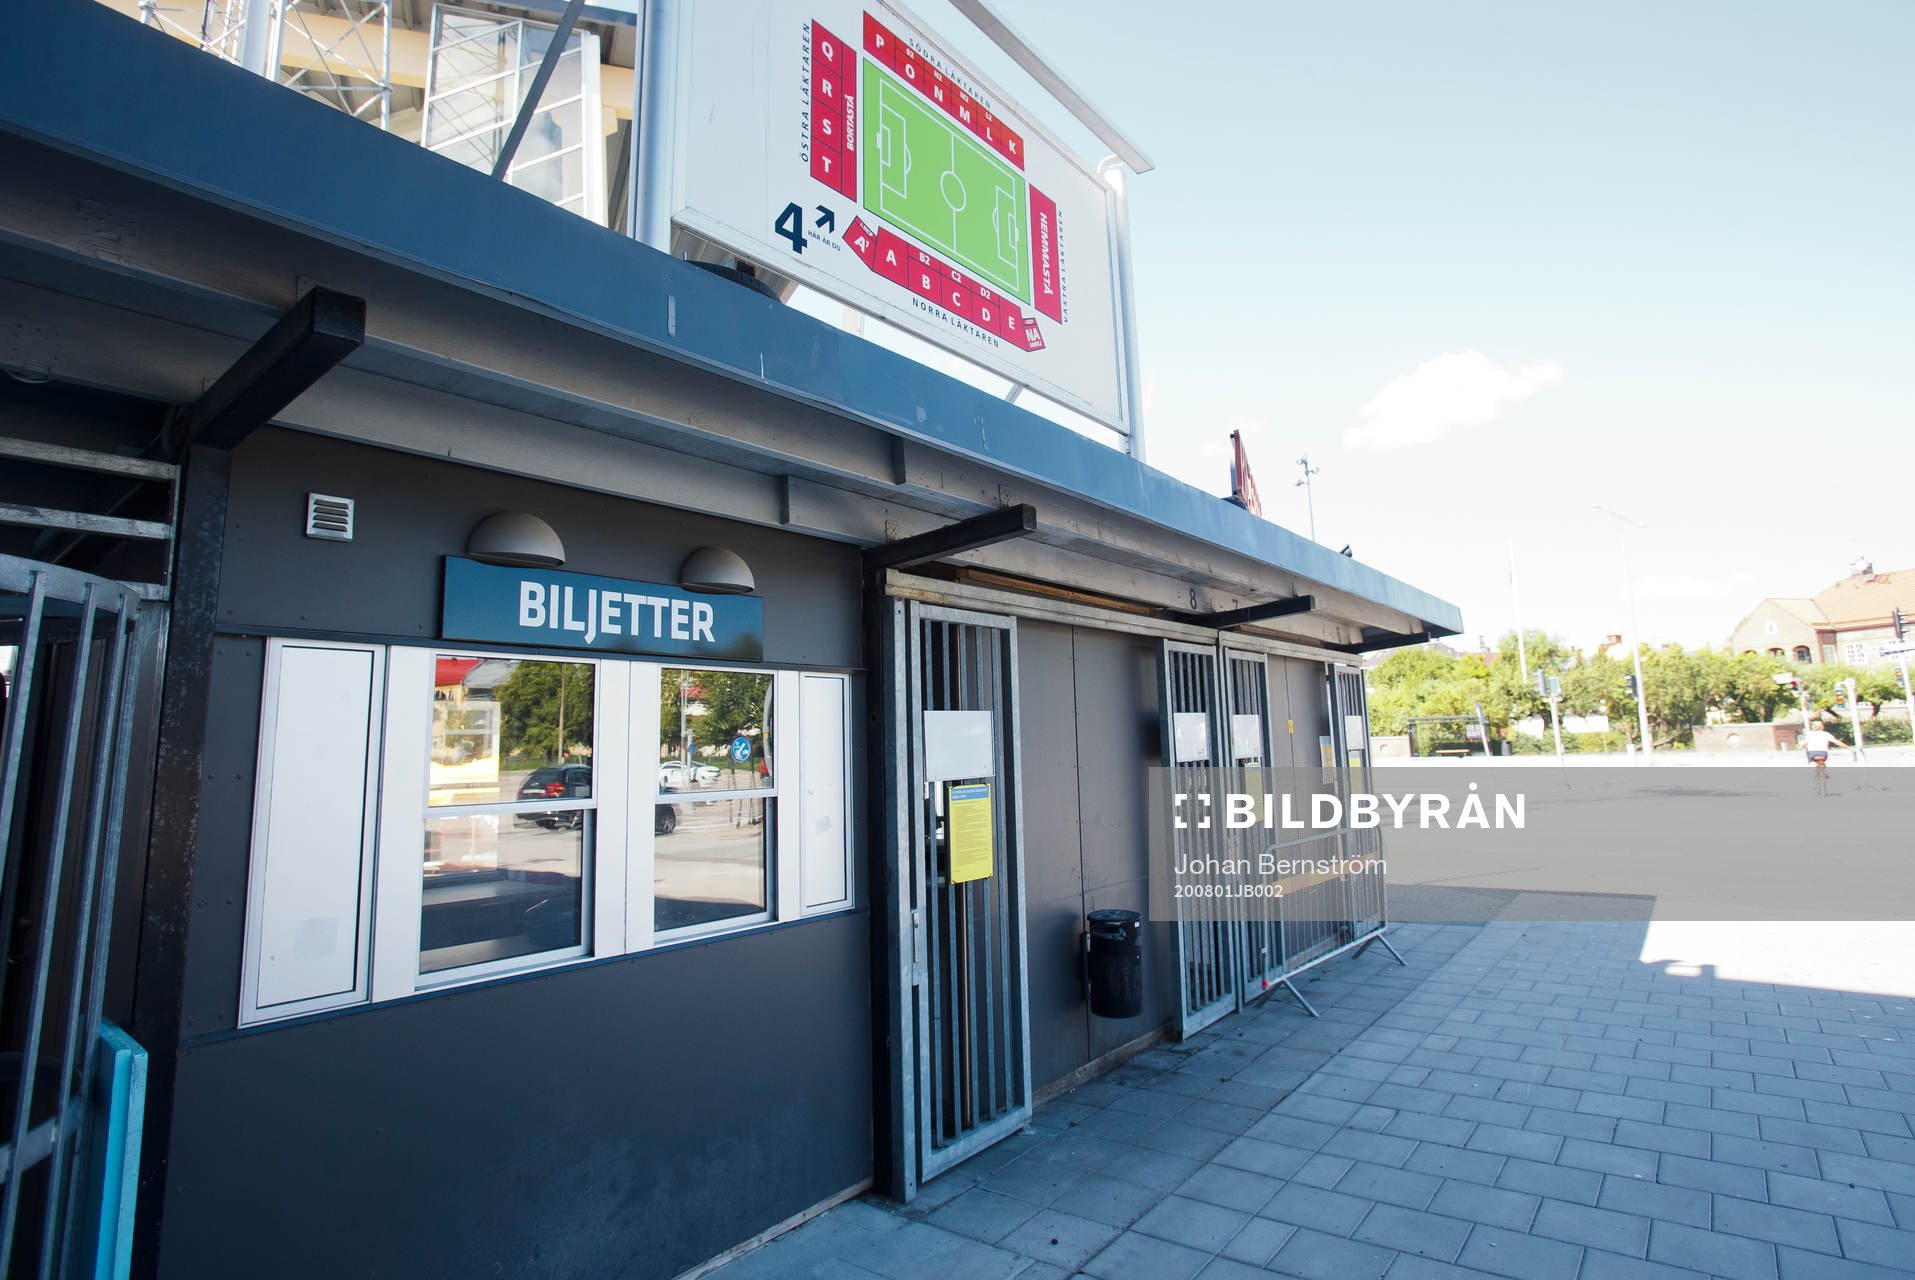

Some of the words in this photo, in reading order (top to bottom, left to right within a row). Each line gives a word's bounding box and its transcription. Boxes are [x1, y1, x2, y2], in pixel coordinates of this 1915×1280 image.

[877, 34, 885, 49] P
[822, 41, 834, 62] Q
[909, 37, 942, 69] SÖDRA
[800, 23, 810, 106] LÄKTAREN
[905, 64, 916, 80] O
[823, 79, 833, 98] R
[934, 86, 944, 103] N
[845, 95, 855, 151] BORTASTÅ
[959, 106, 971, 124] M
[823, 119, 832, 136] S
[986, 127, 993, 141] L
[799, 112, 809, 162] ÖSTRA
[1009, 140, 1017, 155] K
[822, 156, 832, 173] T
[774, 202, 808, 255] 4
[832, 242, 841, 252] DU
[1041, 212, 1054, 296] HEMMASTÅ
[886, 250, 897, 267] A
[919, 252, 931, 266] B2
[923, 274, 931, 290] B
[951, 271, 962, 284] C2
[952, 292, 961, 307] C
[980, 287, 991, 300] D2
[912, 298, 948, 322] NORRA
[951, 318, 999, 348] LÄKTAREN
[982, 308, 991, 322] D
[1008, 316, 1016, 330] E
[1025, 328, 1041, 342] NA
[1189, 587, 1198, 610] 8
[519, 580, 716, 645] BILJETTER
